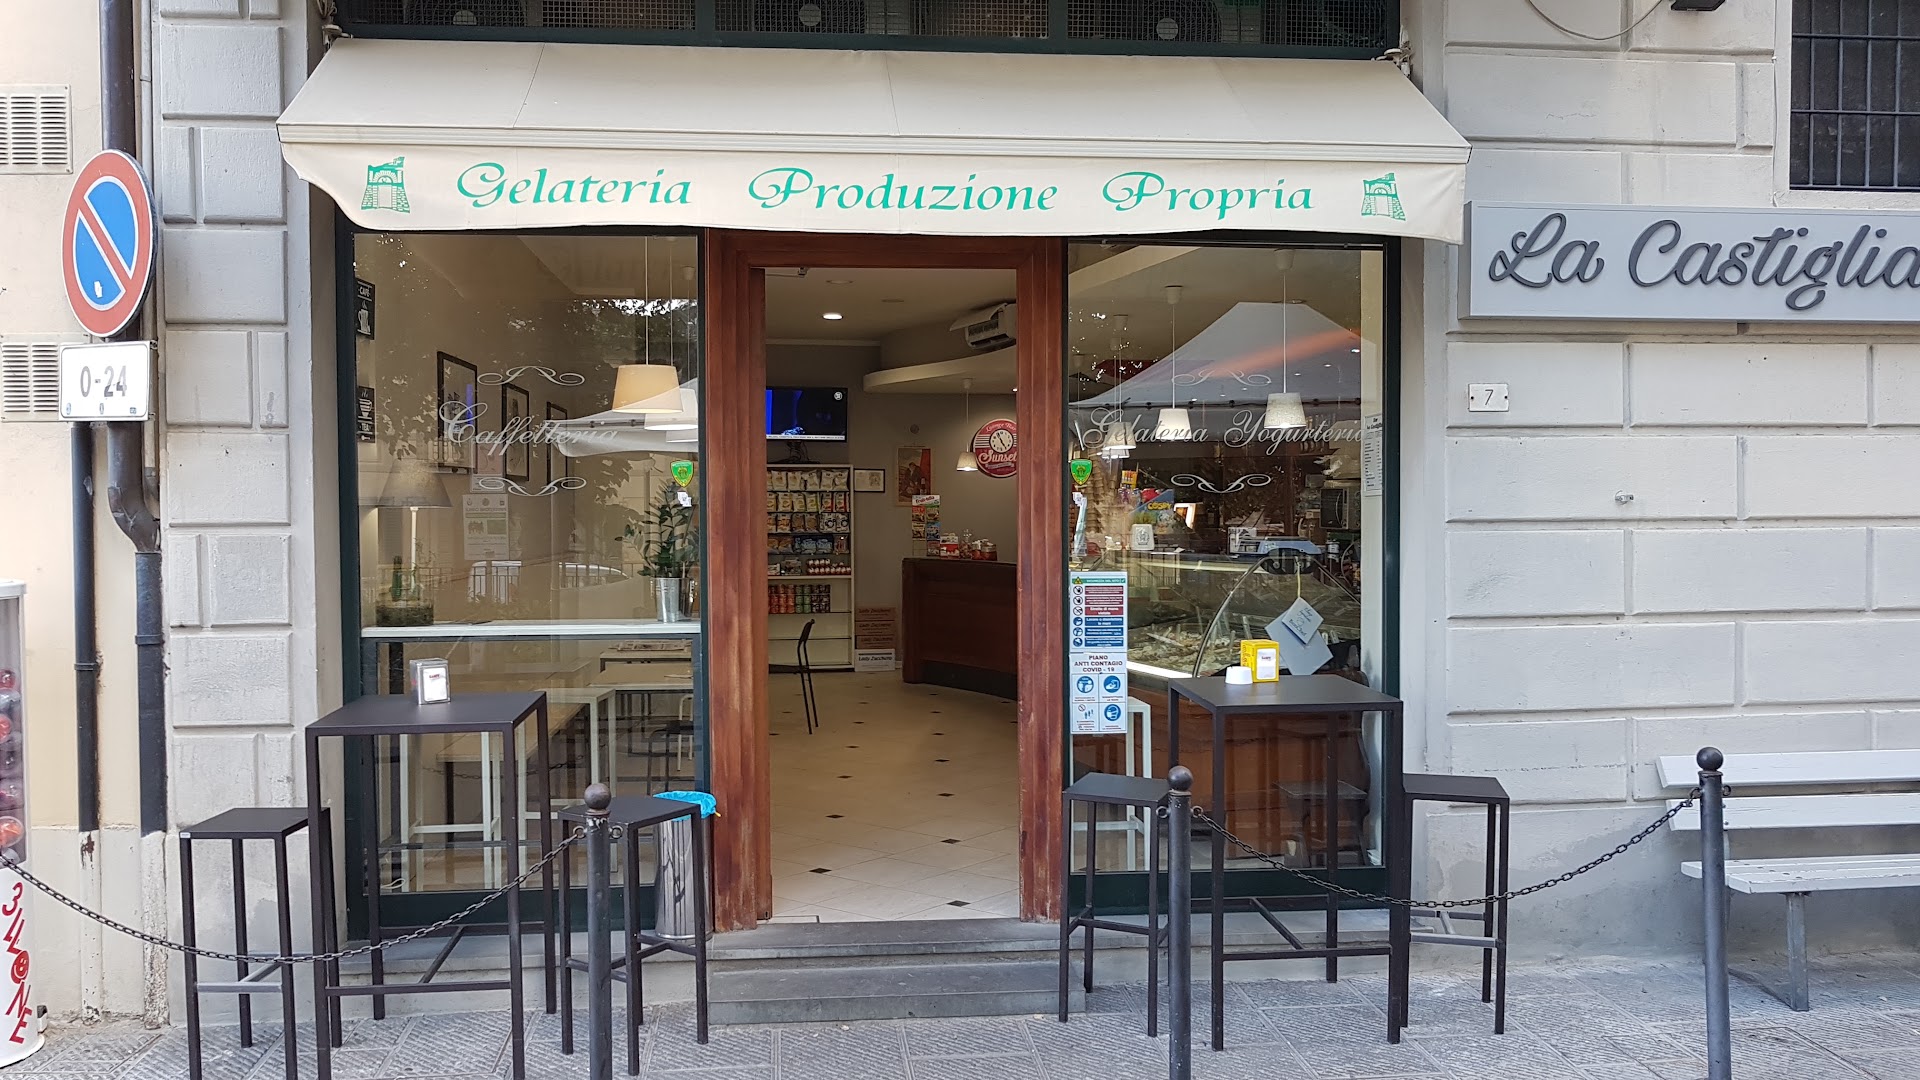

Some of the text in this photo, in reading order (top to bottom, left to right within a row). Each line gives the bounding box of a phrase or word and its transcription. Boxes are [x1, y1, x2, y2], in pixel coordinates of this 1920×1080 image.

[457, 162, 1316, 220] Gelateria Produzione Propria
[1488, 212, 1605, 289] La
[1484, 389, 1494, 406] 7
[439, 400, 618, 456] Caffetteria
[1082, 407, 1366, 456] Gelateria Yogurteria
[978, 450, 1017, 464] Sunset
